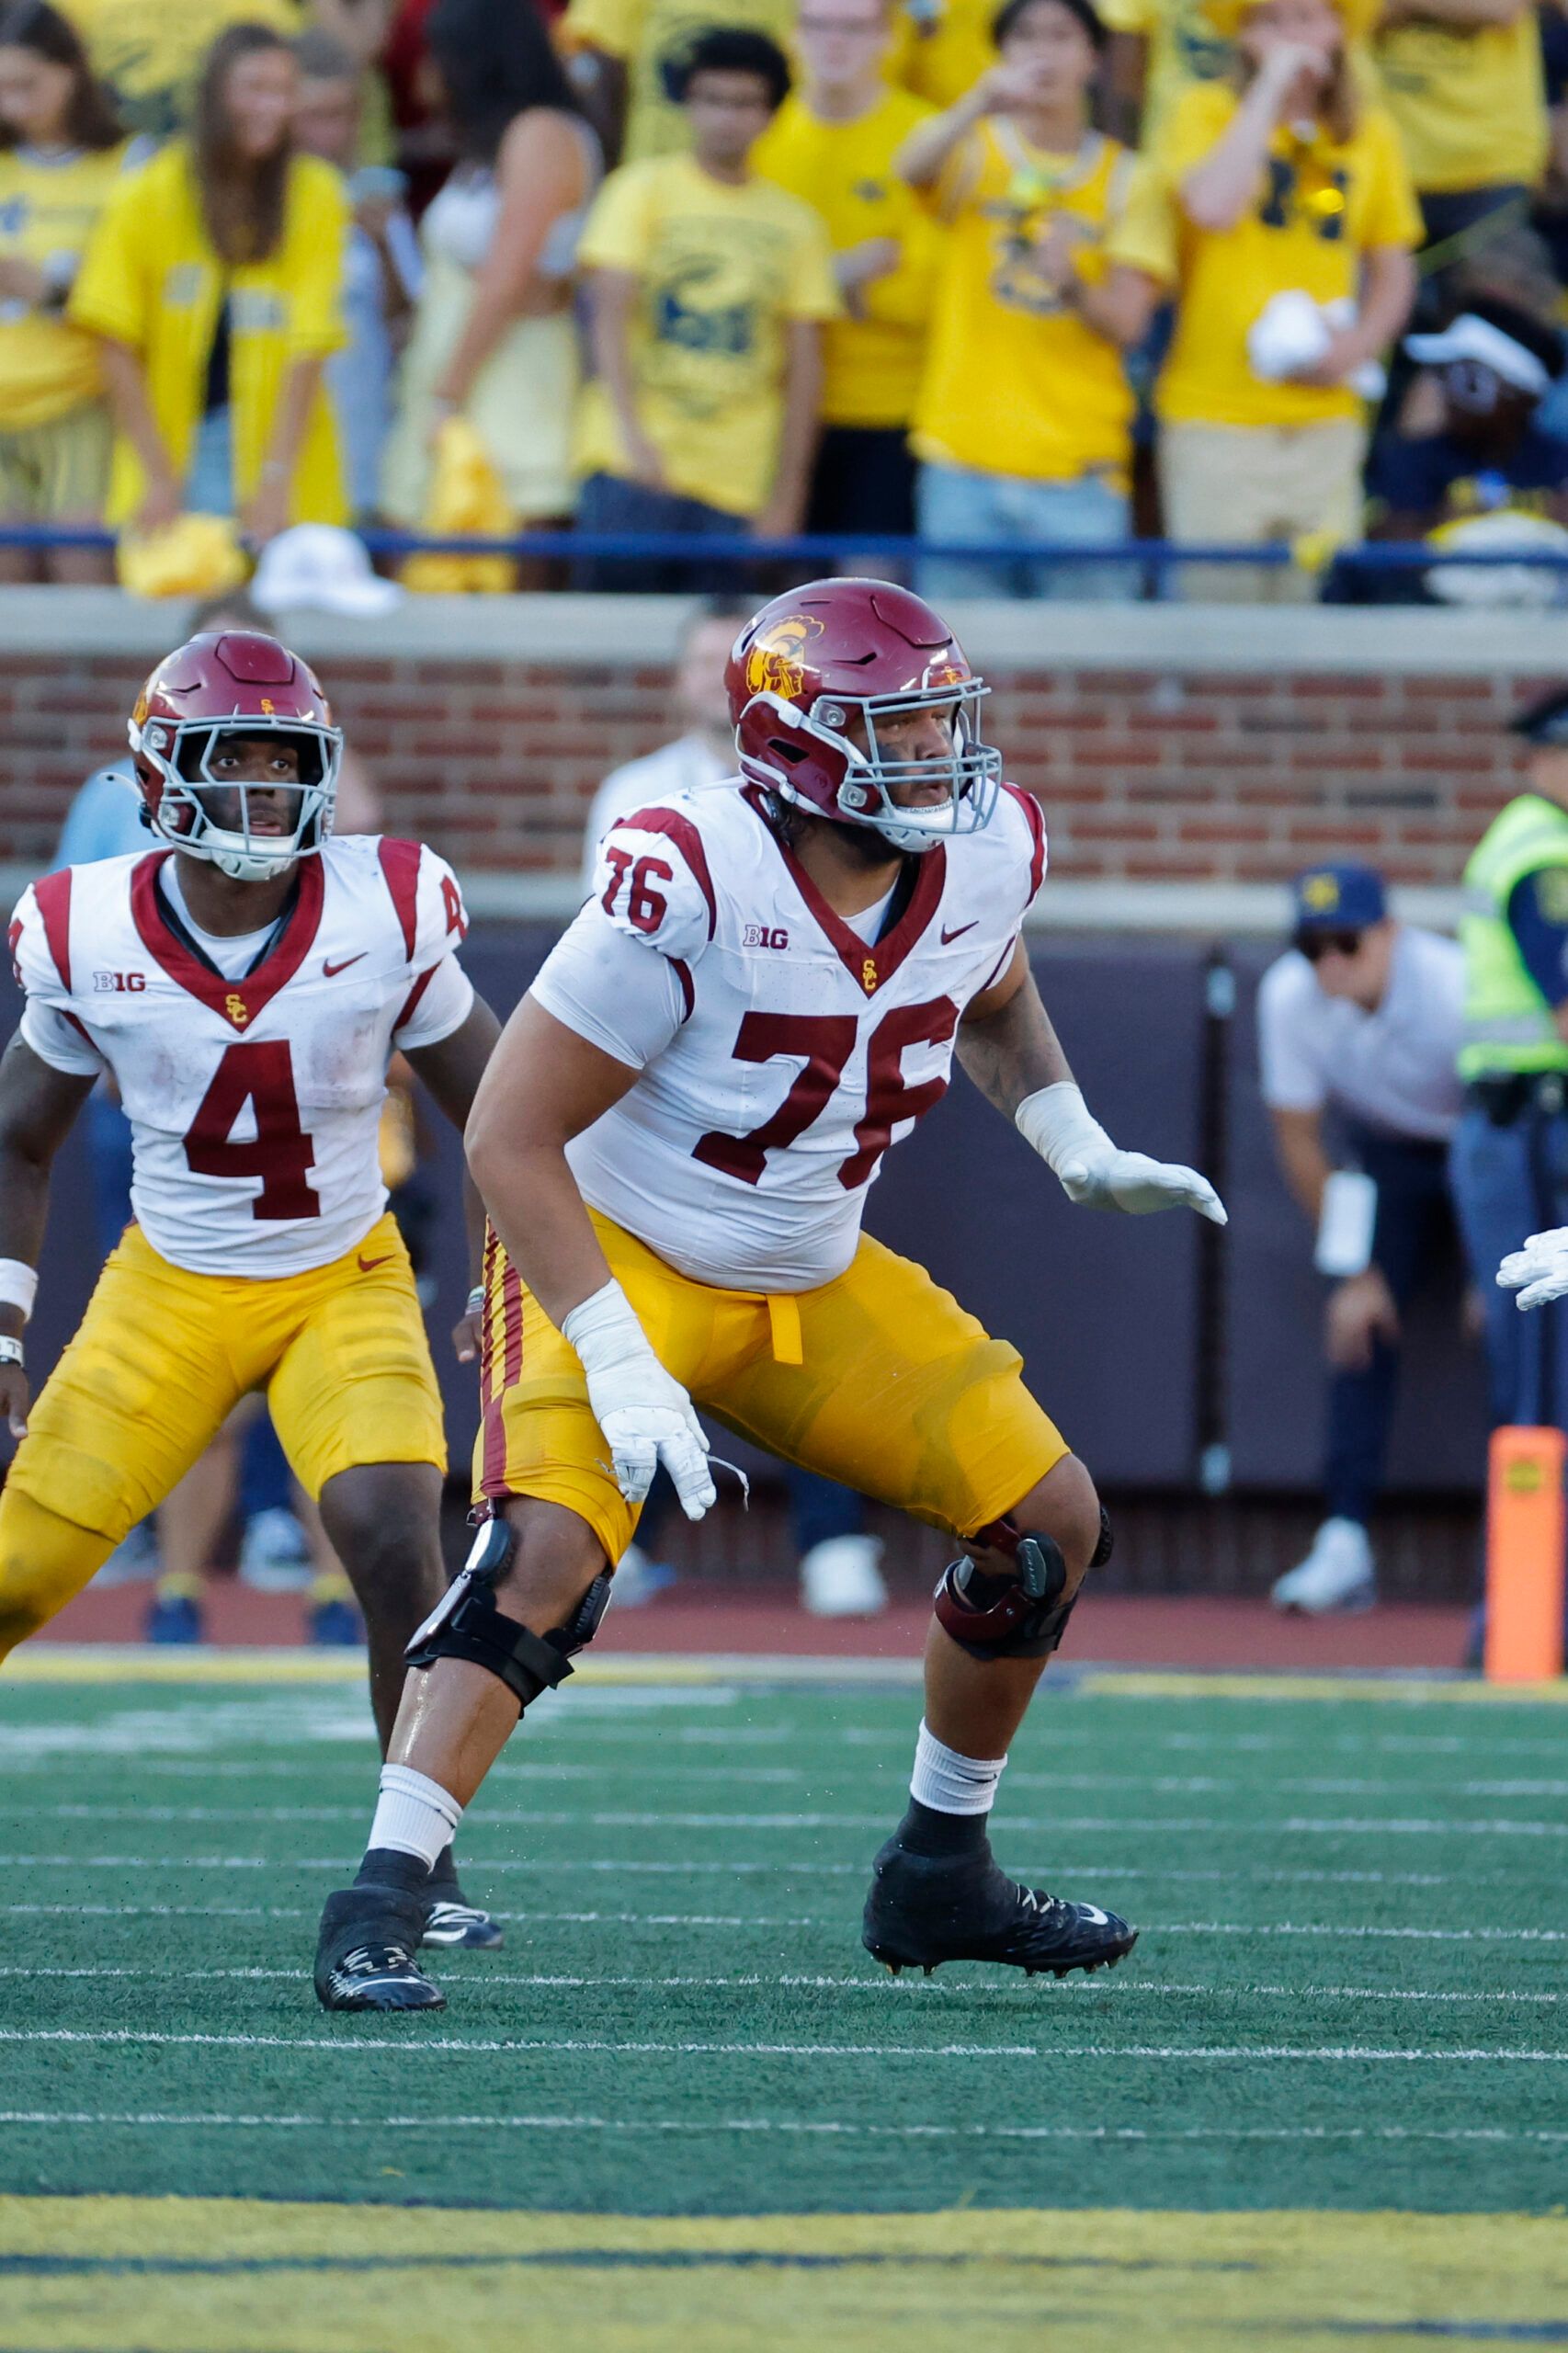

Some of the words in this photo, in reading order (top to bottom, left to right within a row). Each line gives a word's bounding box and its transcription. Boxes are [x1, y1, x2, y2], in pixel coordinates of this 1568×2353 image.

[440, 874, 468, 940] 4
[601, 846, 673, 934] 76
[182, 1039, 321, 1221] 4
[690, 994, 960, 1191] 76
